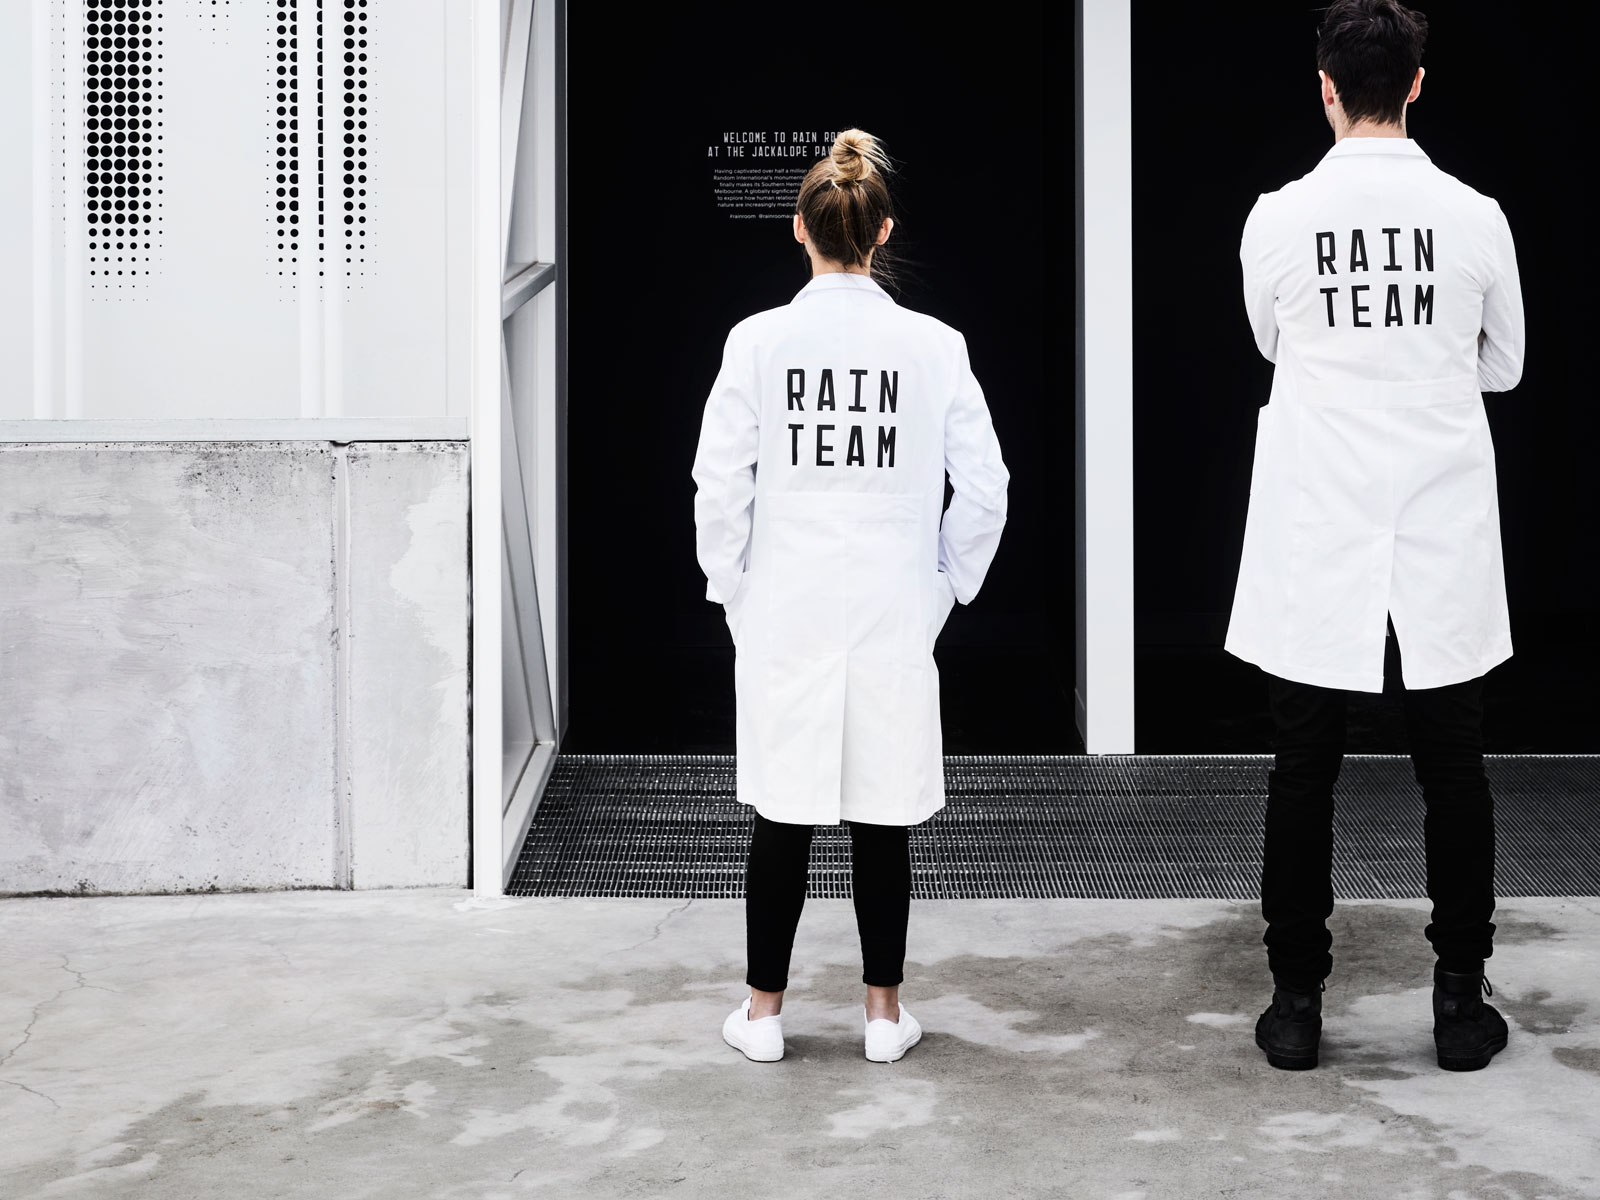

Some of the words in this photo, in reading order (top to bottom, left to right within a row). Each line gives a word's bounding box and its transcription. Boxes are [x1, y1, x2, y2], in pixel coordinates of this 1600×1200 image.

[708, 145, 719, 157] AT
[727, 145, 745, 157] THE
[752, 145, 808, 157] JACKALOPE
[723, 131, 767, 143] WELCOME
[774, 131, 786, 143] TO
[792, 131, 817, 143] RAIN
[824, 131, 840, 143] RO
[1315, 227, 1435, 276] RAIN
[1319, 283, 1435, 328] TEAM
[786, 368, 899, 414] RAIN
[787, 423, 897, 468] TEAM
